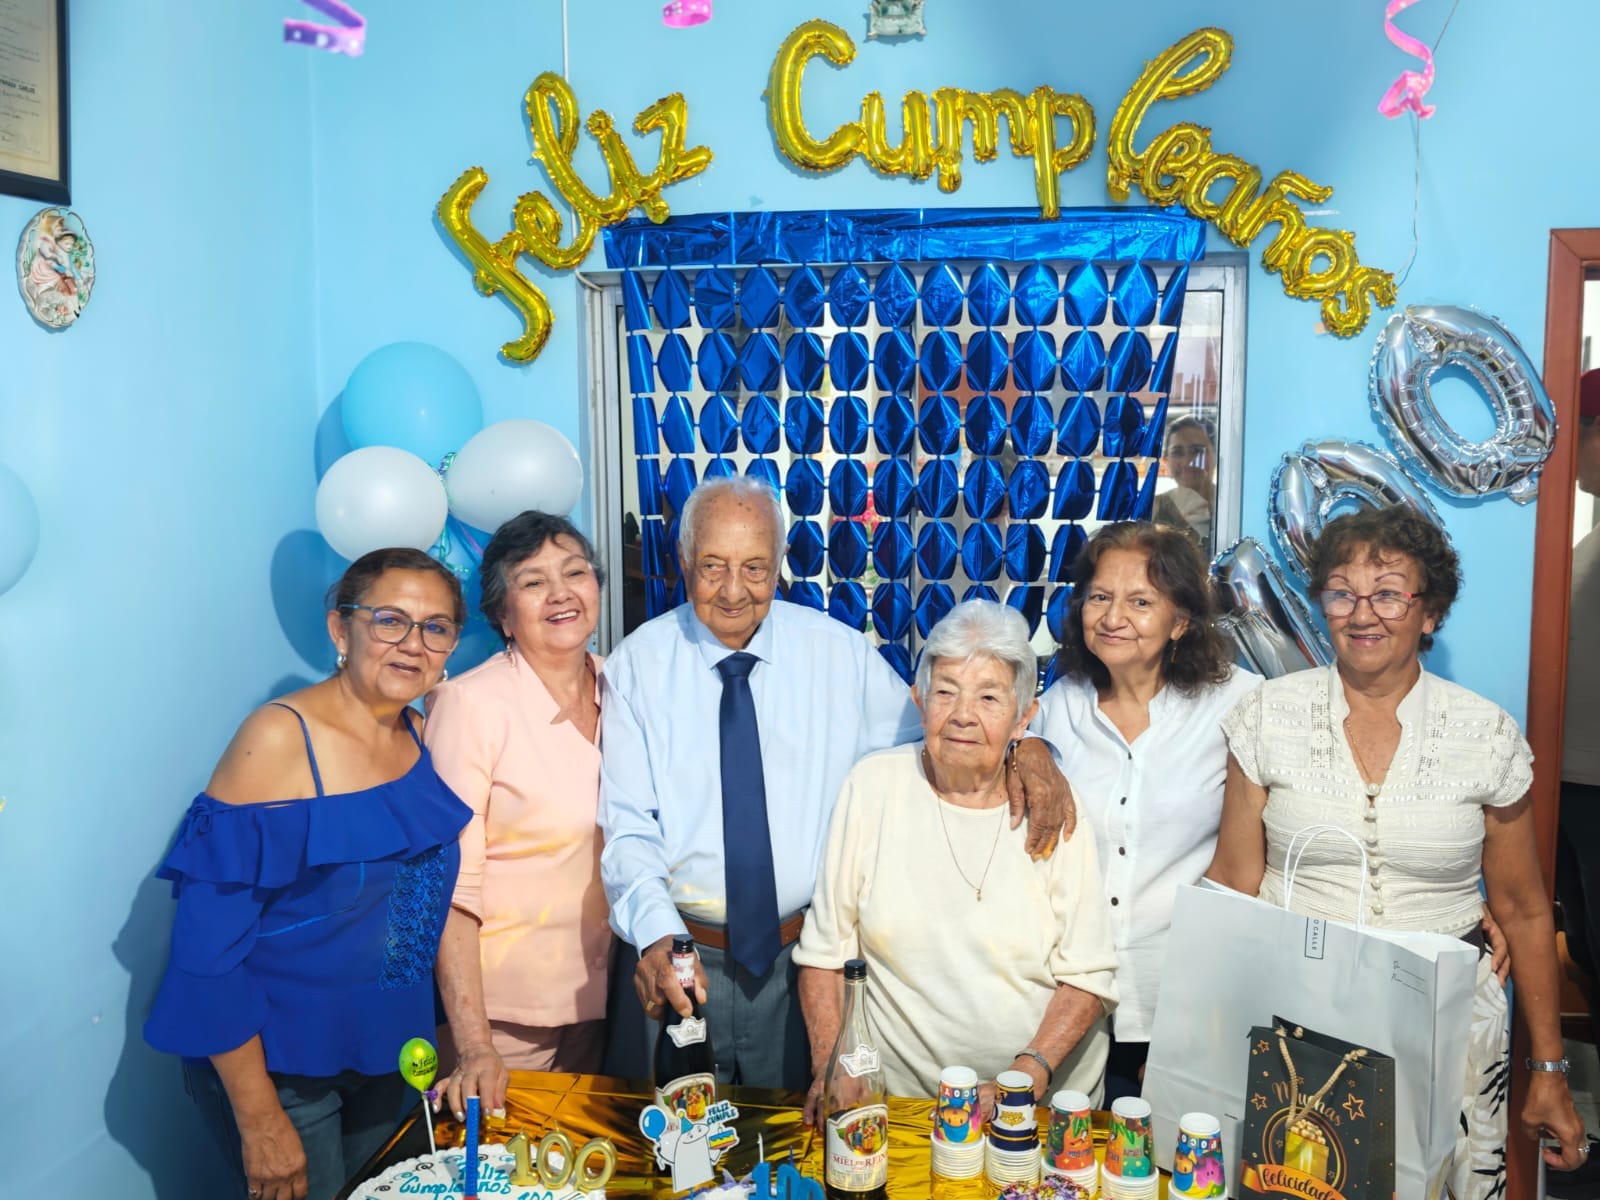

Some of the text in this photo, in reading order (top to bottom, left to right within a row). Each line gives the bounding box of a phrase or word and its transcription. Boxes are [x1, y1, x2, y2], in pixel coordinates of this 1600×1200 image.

[707, 1108, 736, 1125] CUMPLE
[708, 1102, 729, 1115] FELIZ
[506, 1132, 618, 1193] 100
[832, 1155, 854, 1166] MIEL
[400, 1176, 512, 1200] Cumpleños
